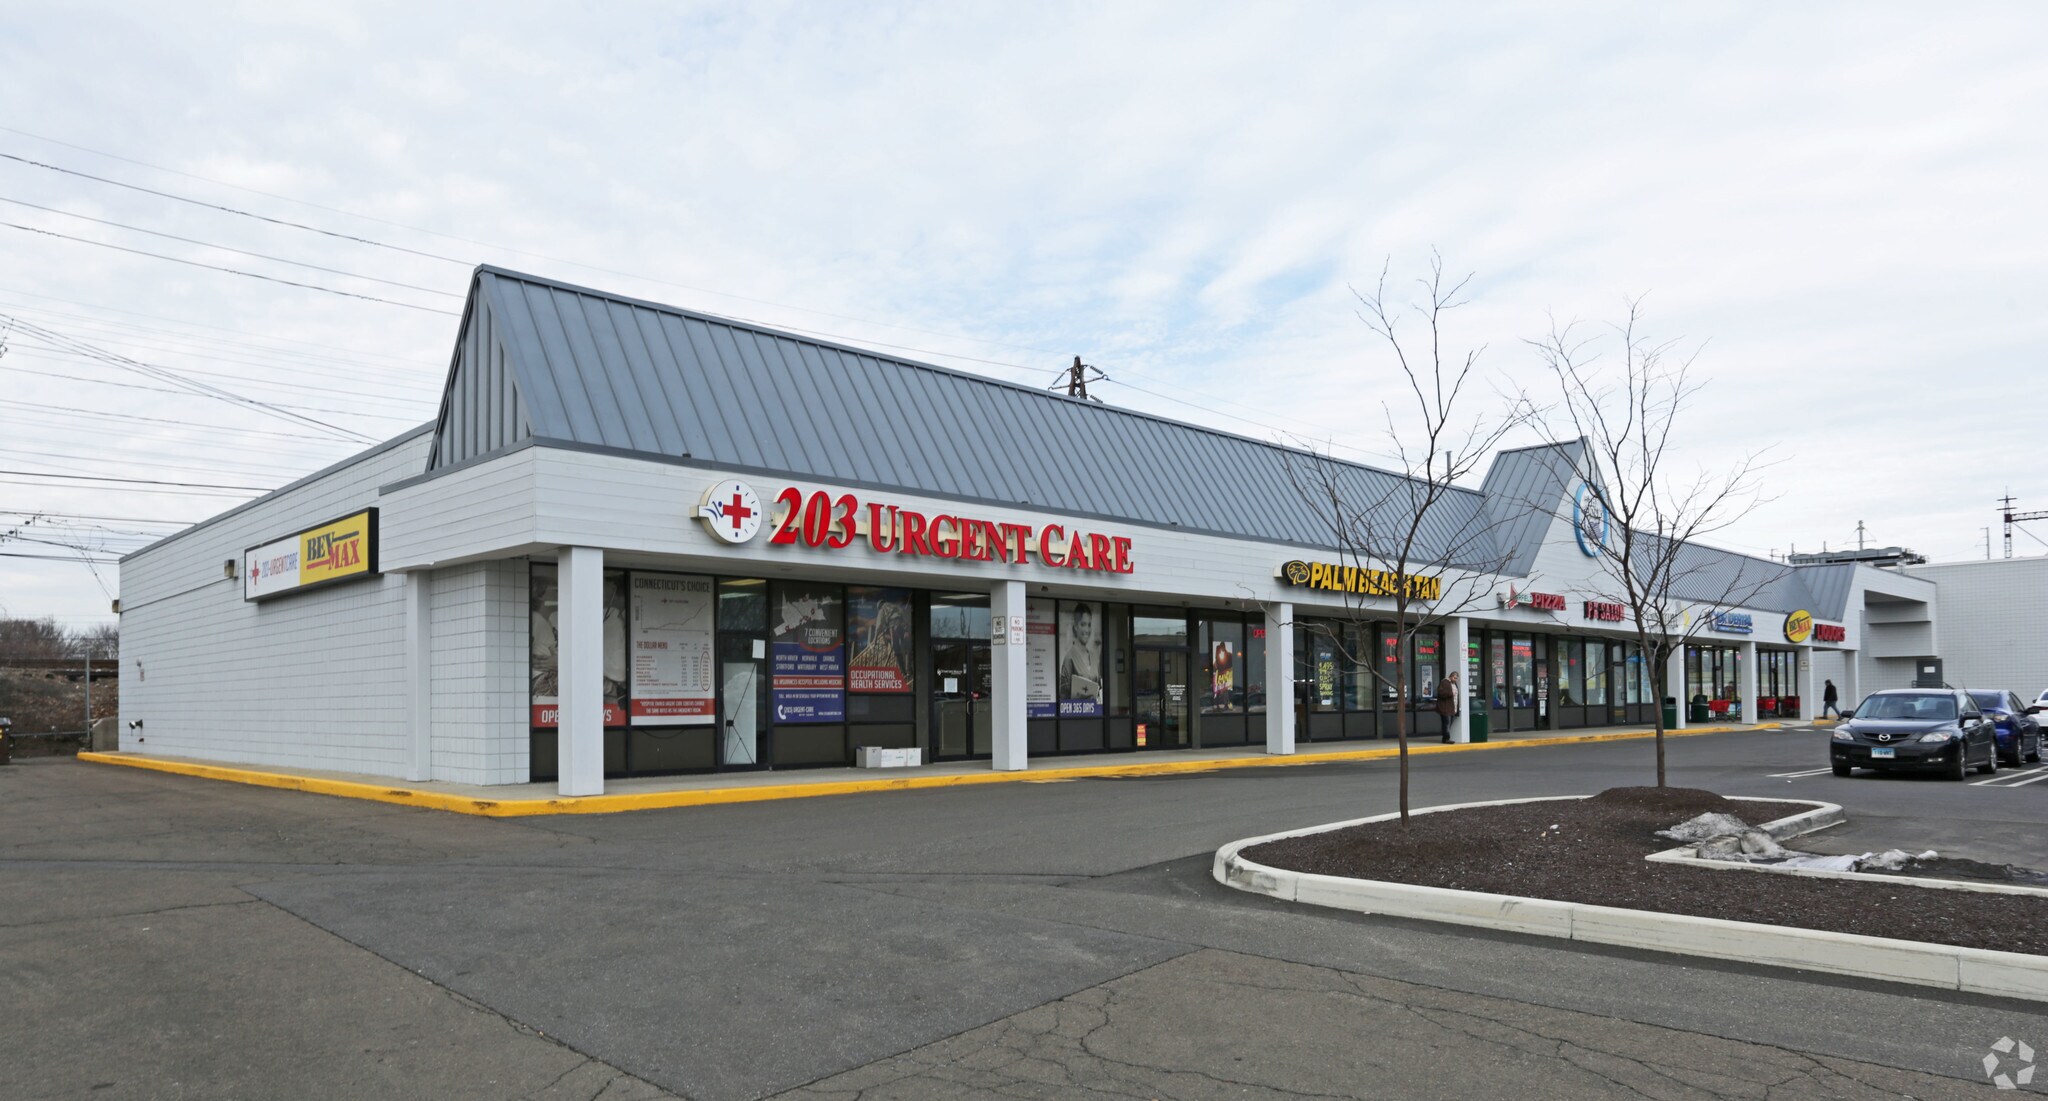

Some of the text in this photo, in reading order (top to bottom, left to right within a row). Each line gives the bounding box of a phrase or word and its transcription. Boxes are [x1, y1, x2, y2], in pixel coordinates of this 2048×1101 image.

[767, 487, 1134, 574] 203 URGENT CARE
[307, 532, 335, 562] BEV
[328, 539, 361, 570] MAX
[634, 577, 711, 593] CONNECTICUT'S CHOICE
[1310, 562, 1442, 600] PALM BEACH TAN
[1534, 593, 1566, 611] PIZZA
[1817, 624, 1845, 642] LIQUORS
[850, 670, 896, 681] OCCUPATIONAL
[850, 679, 903, 689] HEALTH SERVICES
[541, 709, 559, 723] OPE
[1060, 703, 1072, 713] OPEN
[1072, 703, 1082, 713] 365
[1082, 703, 1095, 714] DAYS
